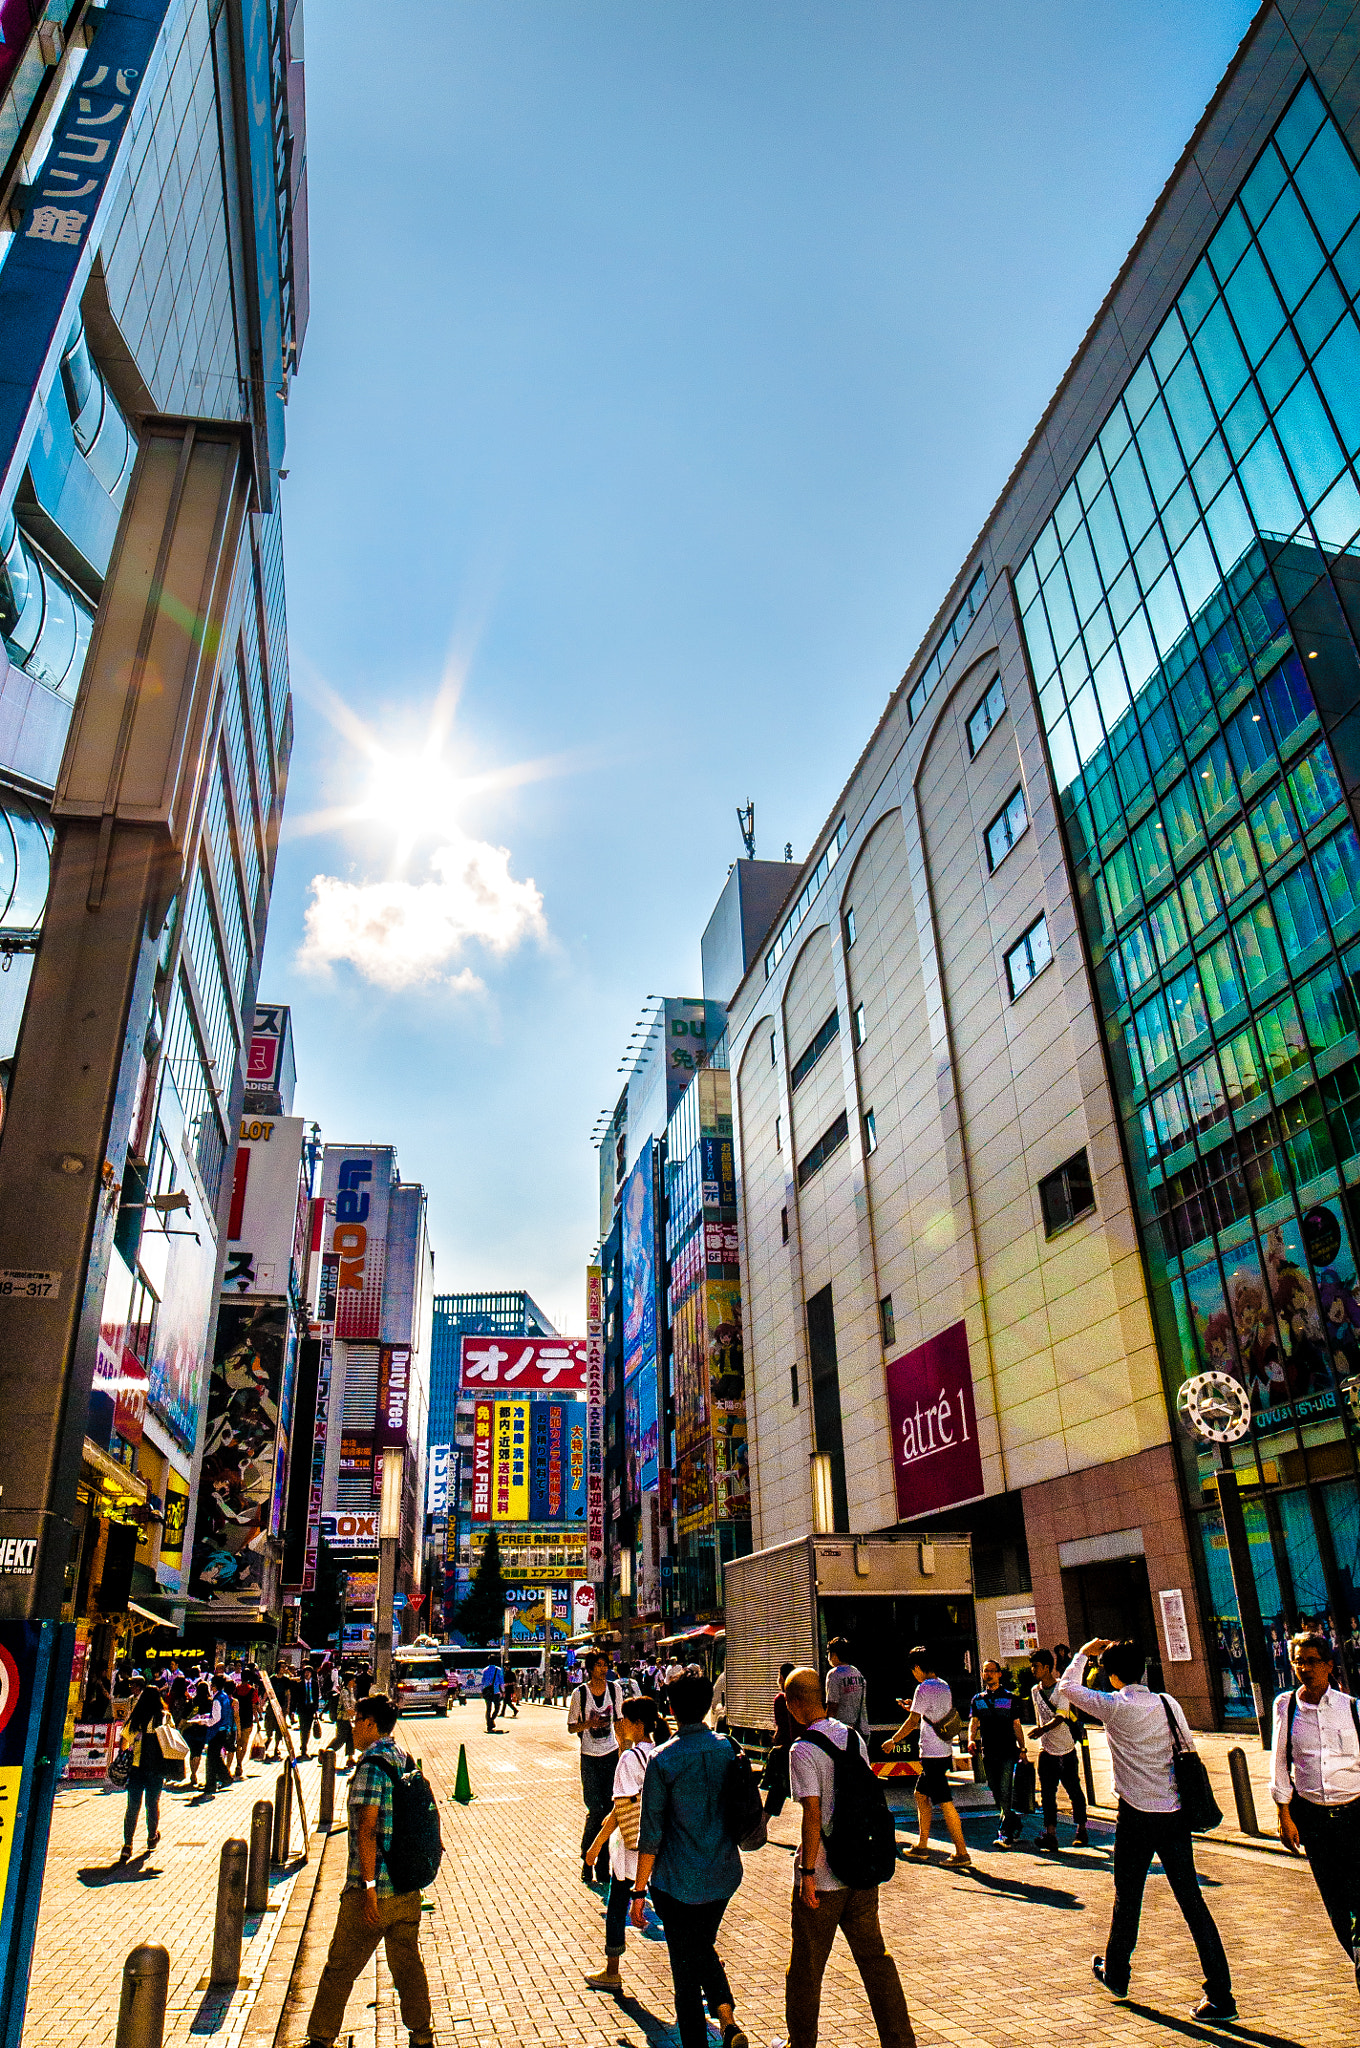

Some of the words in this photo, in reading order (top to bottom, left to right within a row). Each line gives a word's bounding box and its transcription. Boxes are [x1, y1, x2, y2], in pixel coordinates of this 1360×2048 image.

[26, 65, 138, 245] パソコン館
[240, 1121, 274, 1141] LOT
[721, 1143, 733, 1203] お部屋探しは
[704, 1191, 719, 1203] 7F
[708, 1252, 720, 1261] 6F
[389, 1351, 409, 1388] Duty
[589, 1340, 601, 1404] TAKARADA
[388, 1391, 407, 1428] Free
[476, 1406, 490, 1437] 免税
[902, 1388, 954, 1459] atré
[956, 1388, 970, 1442] 1
[475, 1440, 490, 1469] TAX
[448, 1451, 459, 1507] Panasonic
[473, 1473, 489, 1514] FREE
[447, 1515, 456, 1562] ONODEN
[502, 1535, 532, 1544] FREE
[12, 1567, 33, 1575] CREW
[531, 1569, 563, 1577] エアコン
